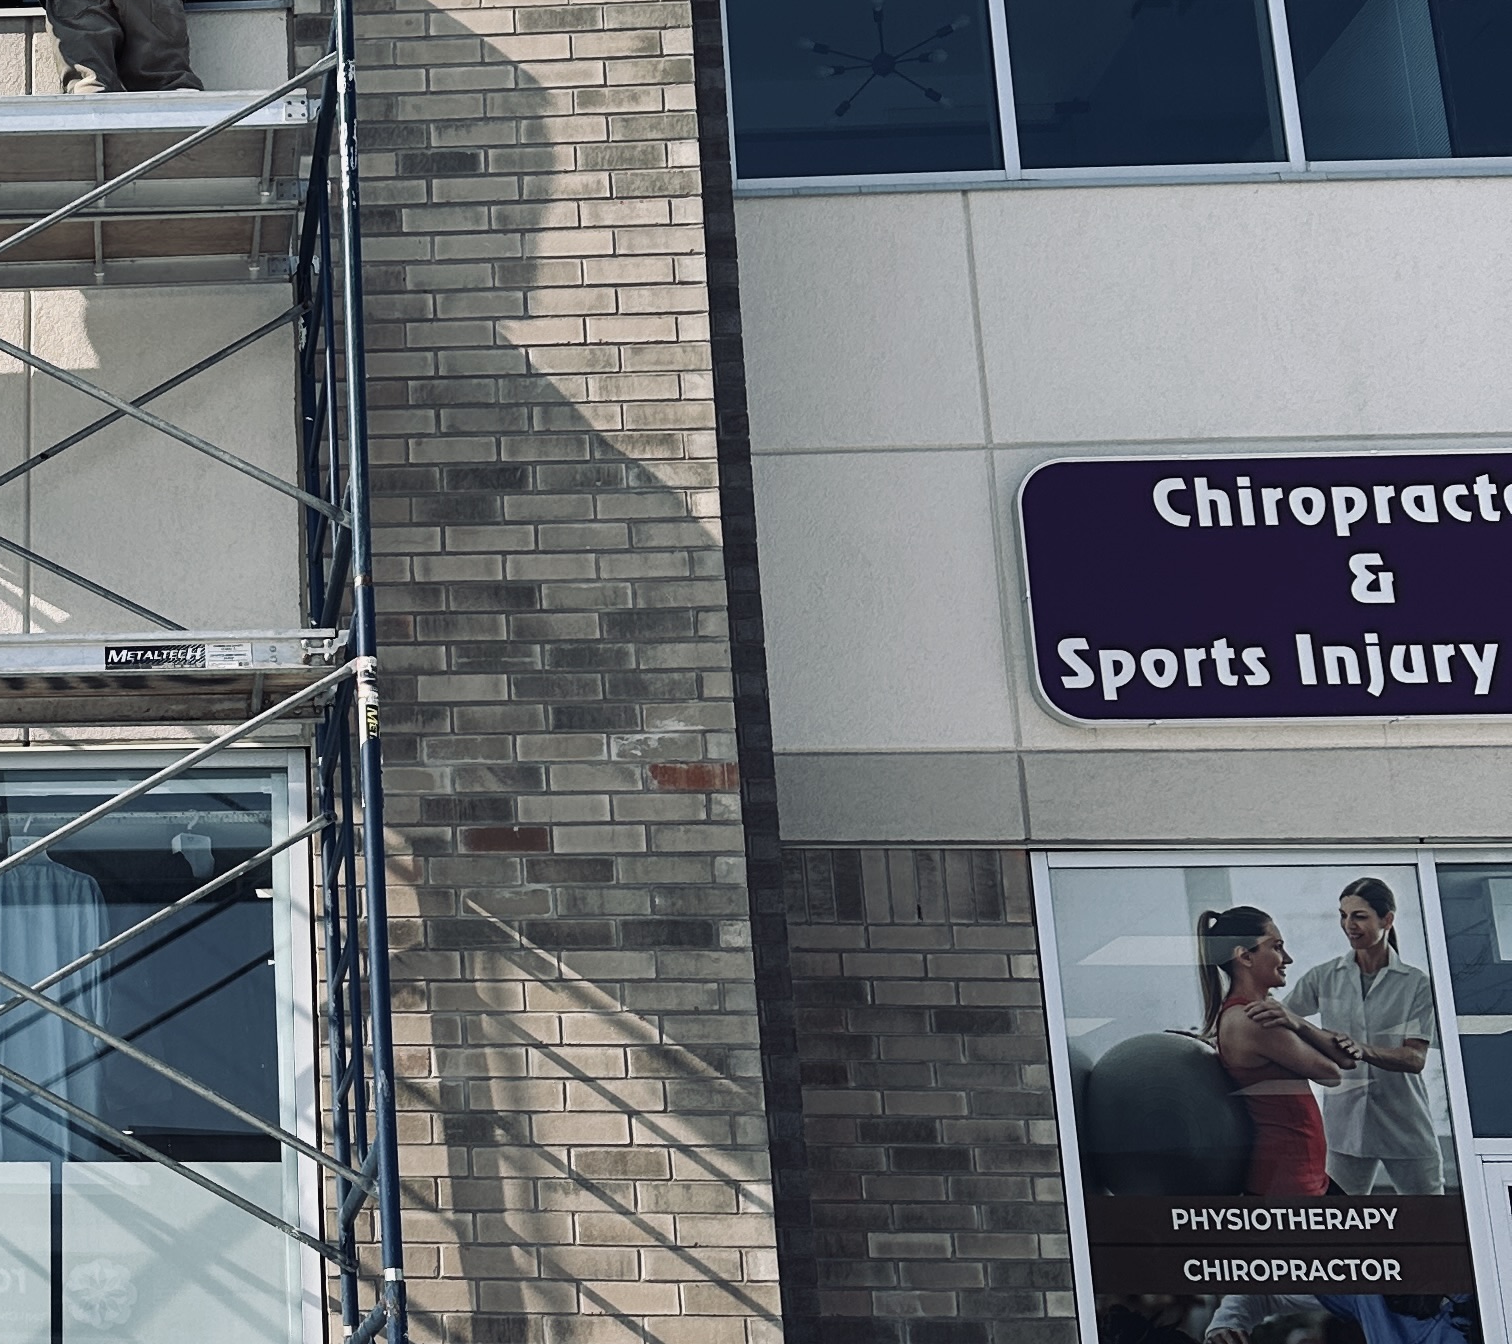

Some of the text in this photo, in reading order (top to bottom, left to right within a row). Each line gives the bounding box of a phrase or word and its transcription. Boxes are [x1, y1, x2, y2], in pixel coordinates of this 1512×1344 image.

[1152, 473, 1512, 536] Chiropract
[1348, 553, 1396, 604] &
[108, 646, 203, 663] METALTECH
[1057, 633, 1499, 701] Sports Injury
[1171, 1207, 1398, 1231] PHYSIOTHERAPY
[1183, 1258, 1402, 1282] CHIROPRACTOR
